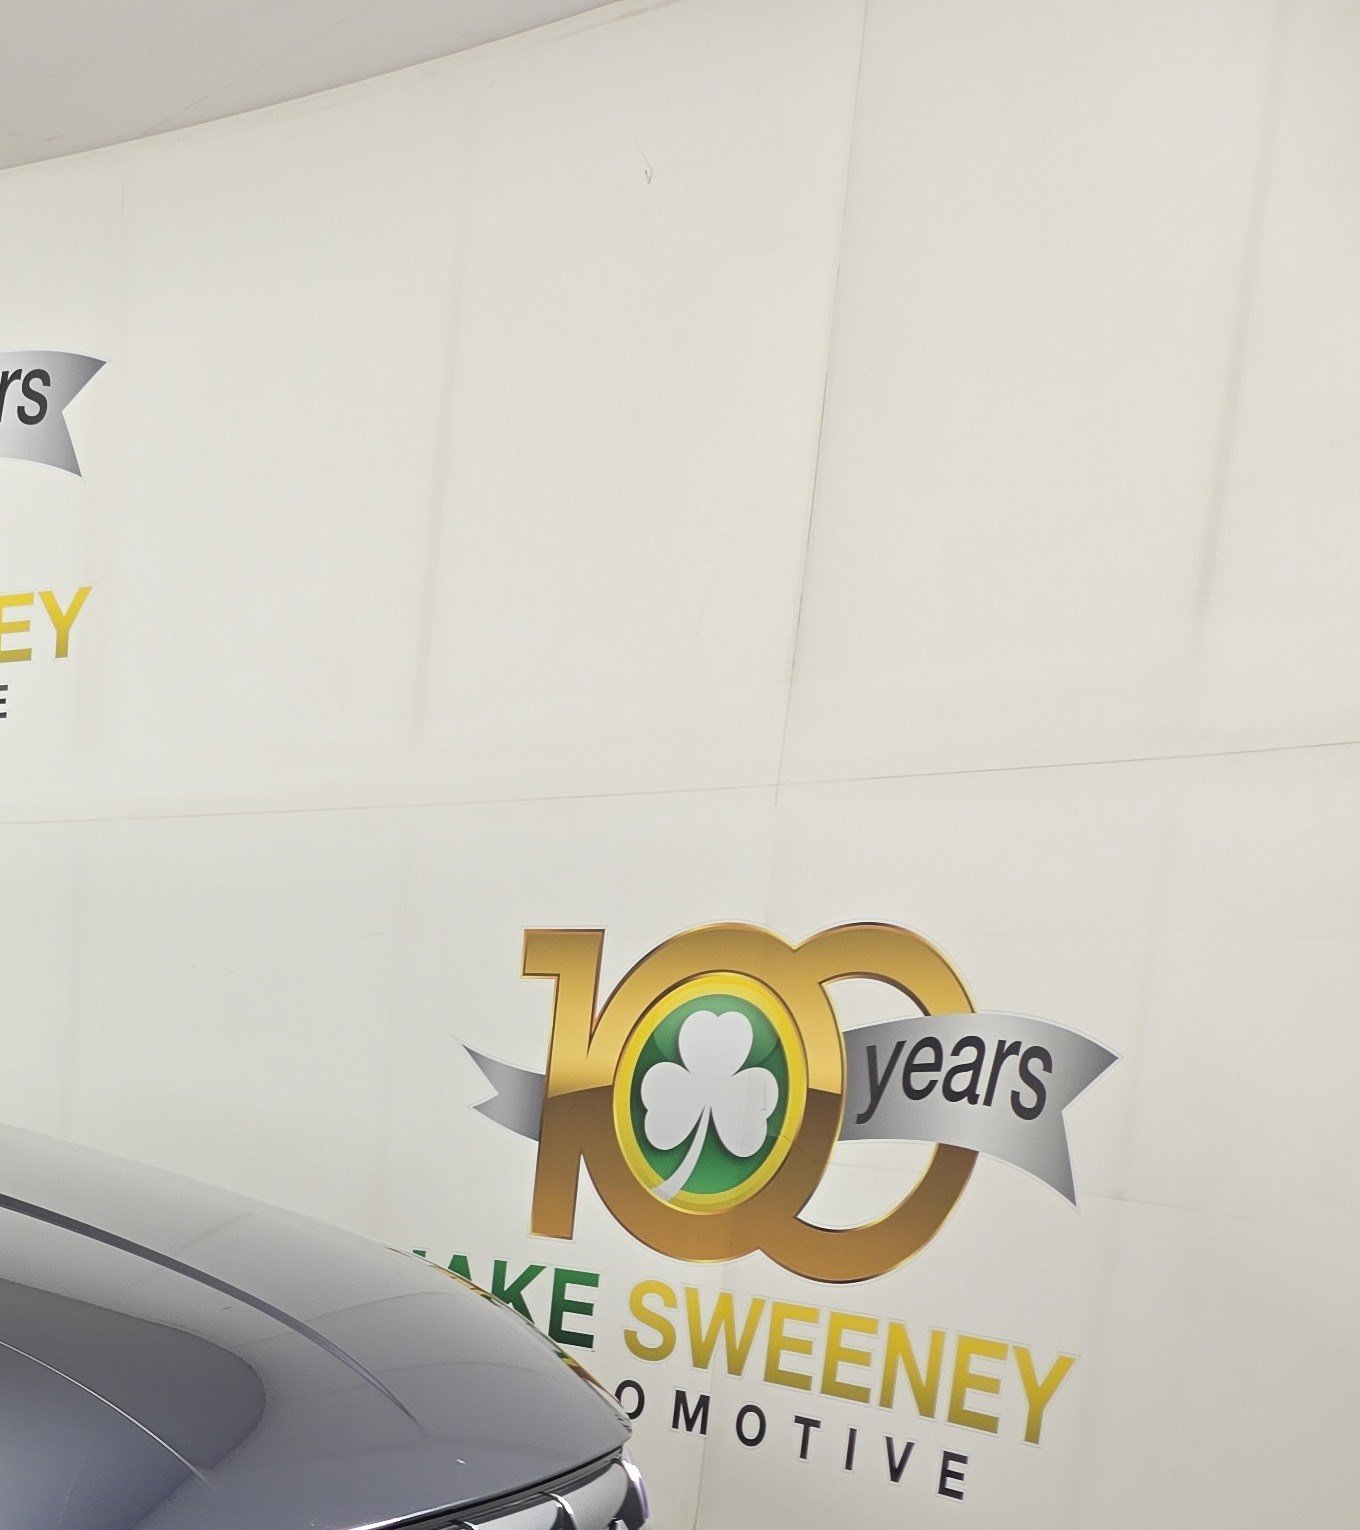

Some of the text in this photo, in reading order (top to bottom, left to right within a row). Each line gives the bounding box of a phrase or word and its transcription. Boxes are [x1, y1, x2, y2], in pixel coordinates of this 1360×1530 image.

[521, 922, 980, 1284] 100
[855, 1035, 1053, 1125] years
[623, 1280, 1076, 1446] SWEENEY
[615, 1379, 970, 1502] OMOTIVE
